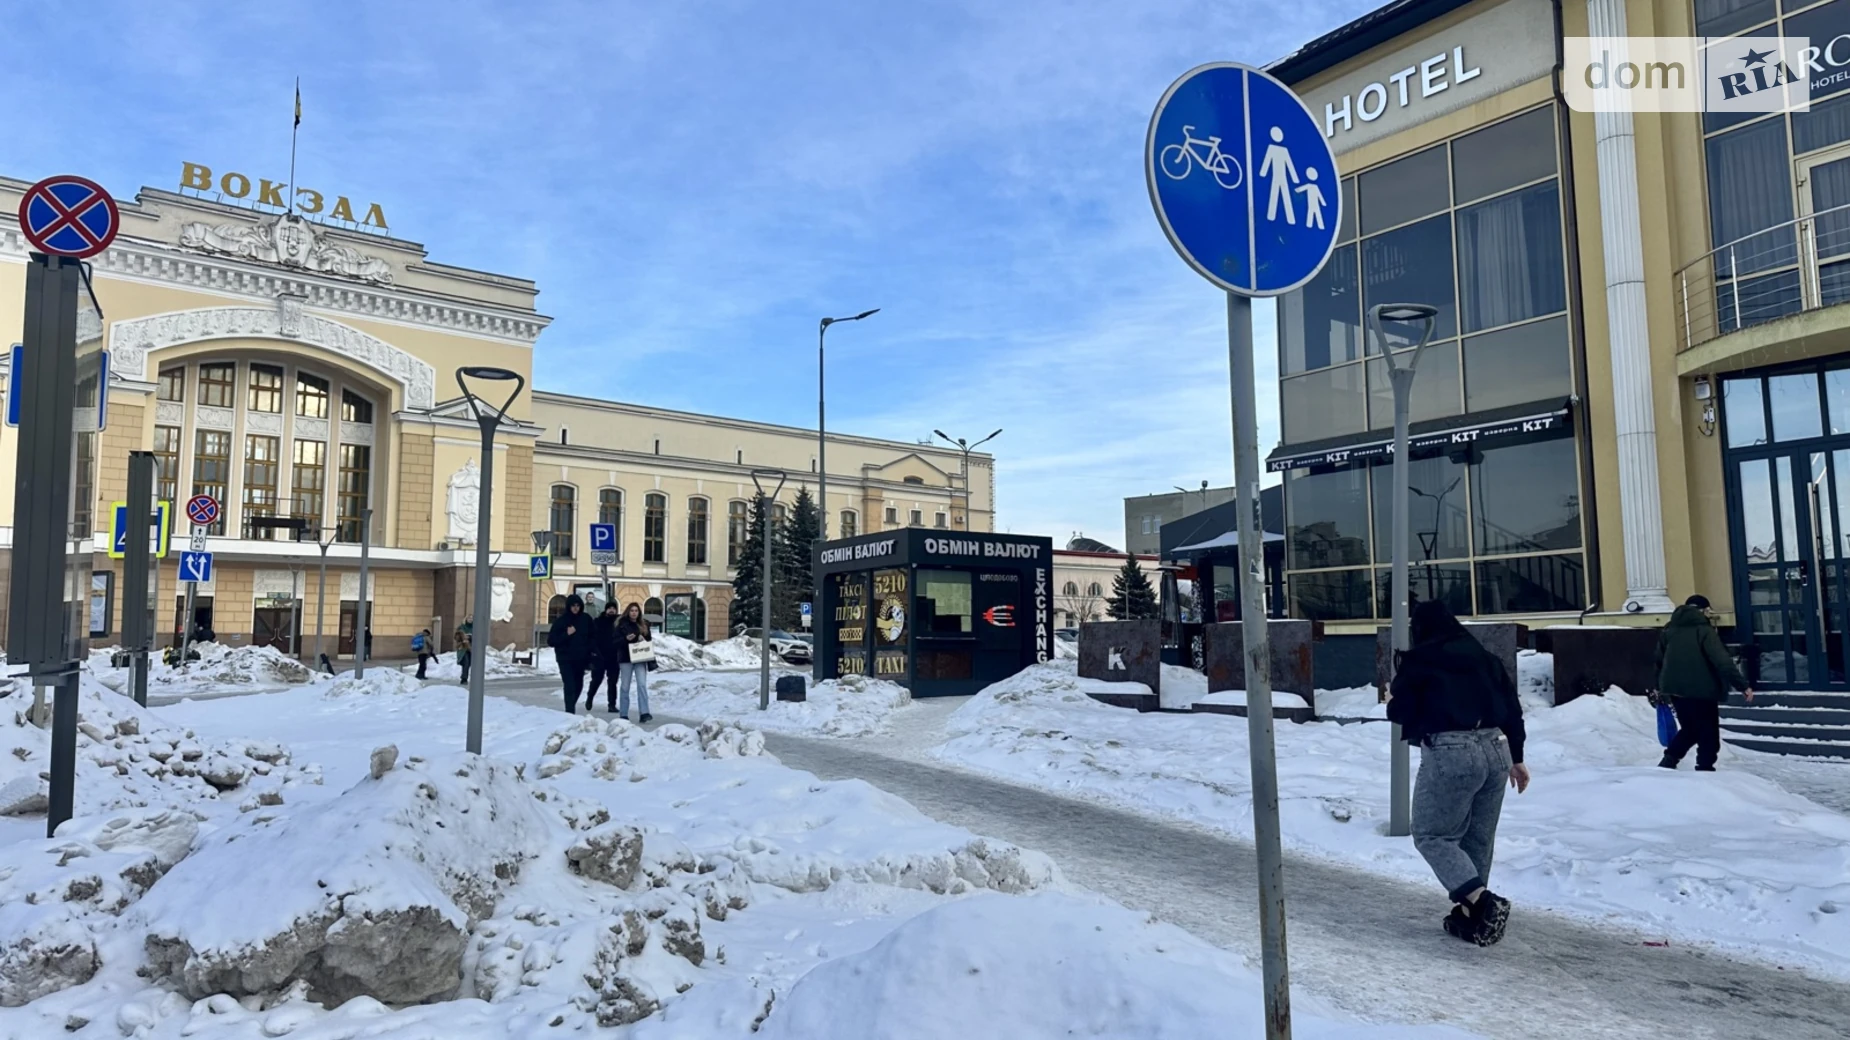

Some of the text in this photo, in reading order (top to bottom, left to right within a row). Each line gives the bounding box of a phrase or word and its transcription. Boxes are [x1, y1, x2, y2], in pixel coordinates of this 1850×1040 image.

[1811, 70, 1850, 90] HOTEL
[1325, 45, 1481, 139] HOTEL
[182, 161, 388, 228] ВОКЗАЛ
[595, 527, 609, 547] P
[821, 539, 895, 564] ОБМІН ВАЛЮТ
[924, 538, 1041, 559] ОБМІН ВАЛЮТ
[839, 583, 863, 598] ТАКСІ
[875, 574, 906, 594] 5210
[835, 605, 867, 621] ПІЛОТ
[1035, 568, 1048, 664] EXCHANG
[837, 657, 864, 674] 5210
[877, 656, 905, 674] TAXI
